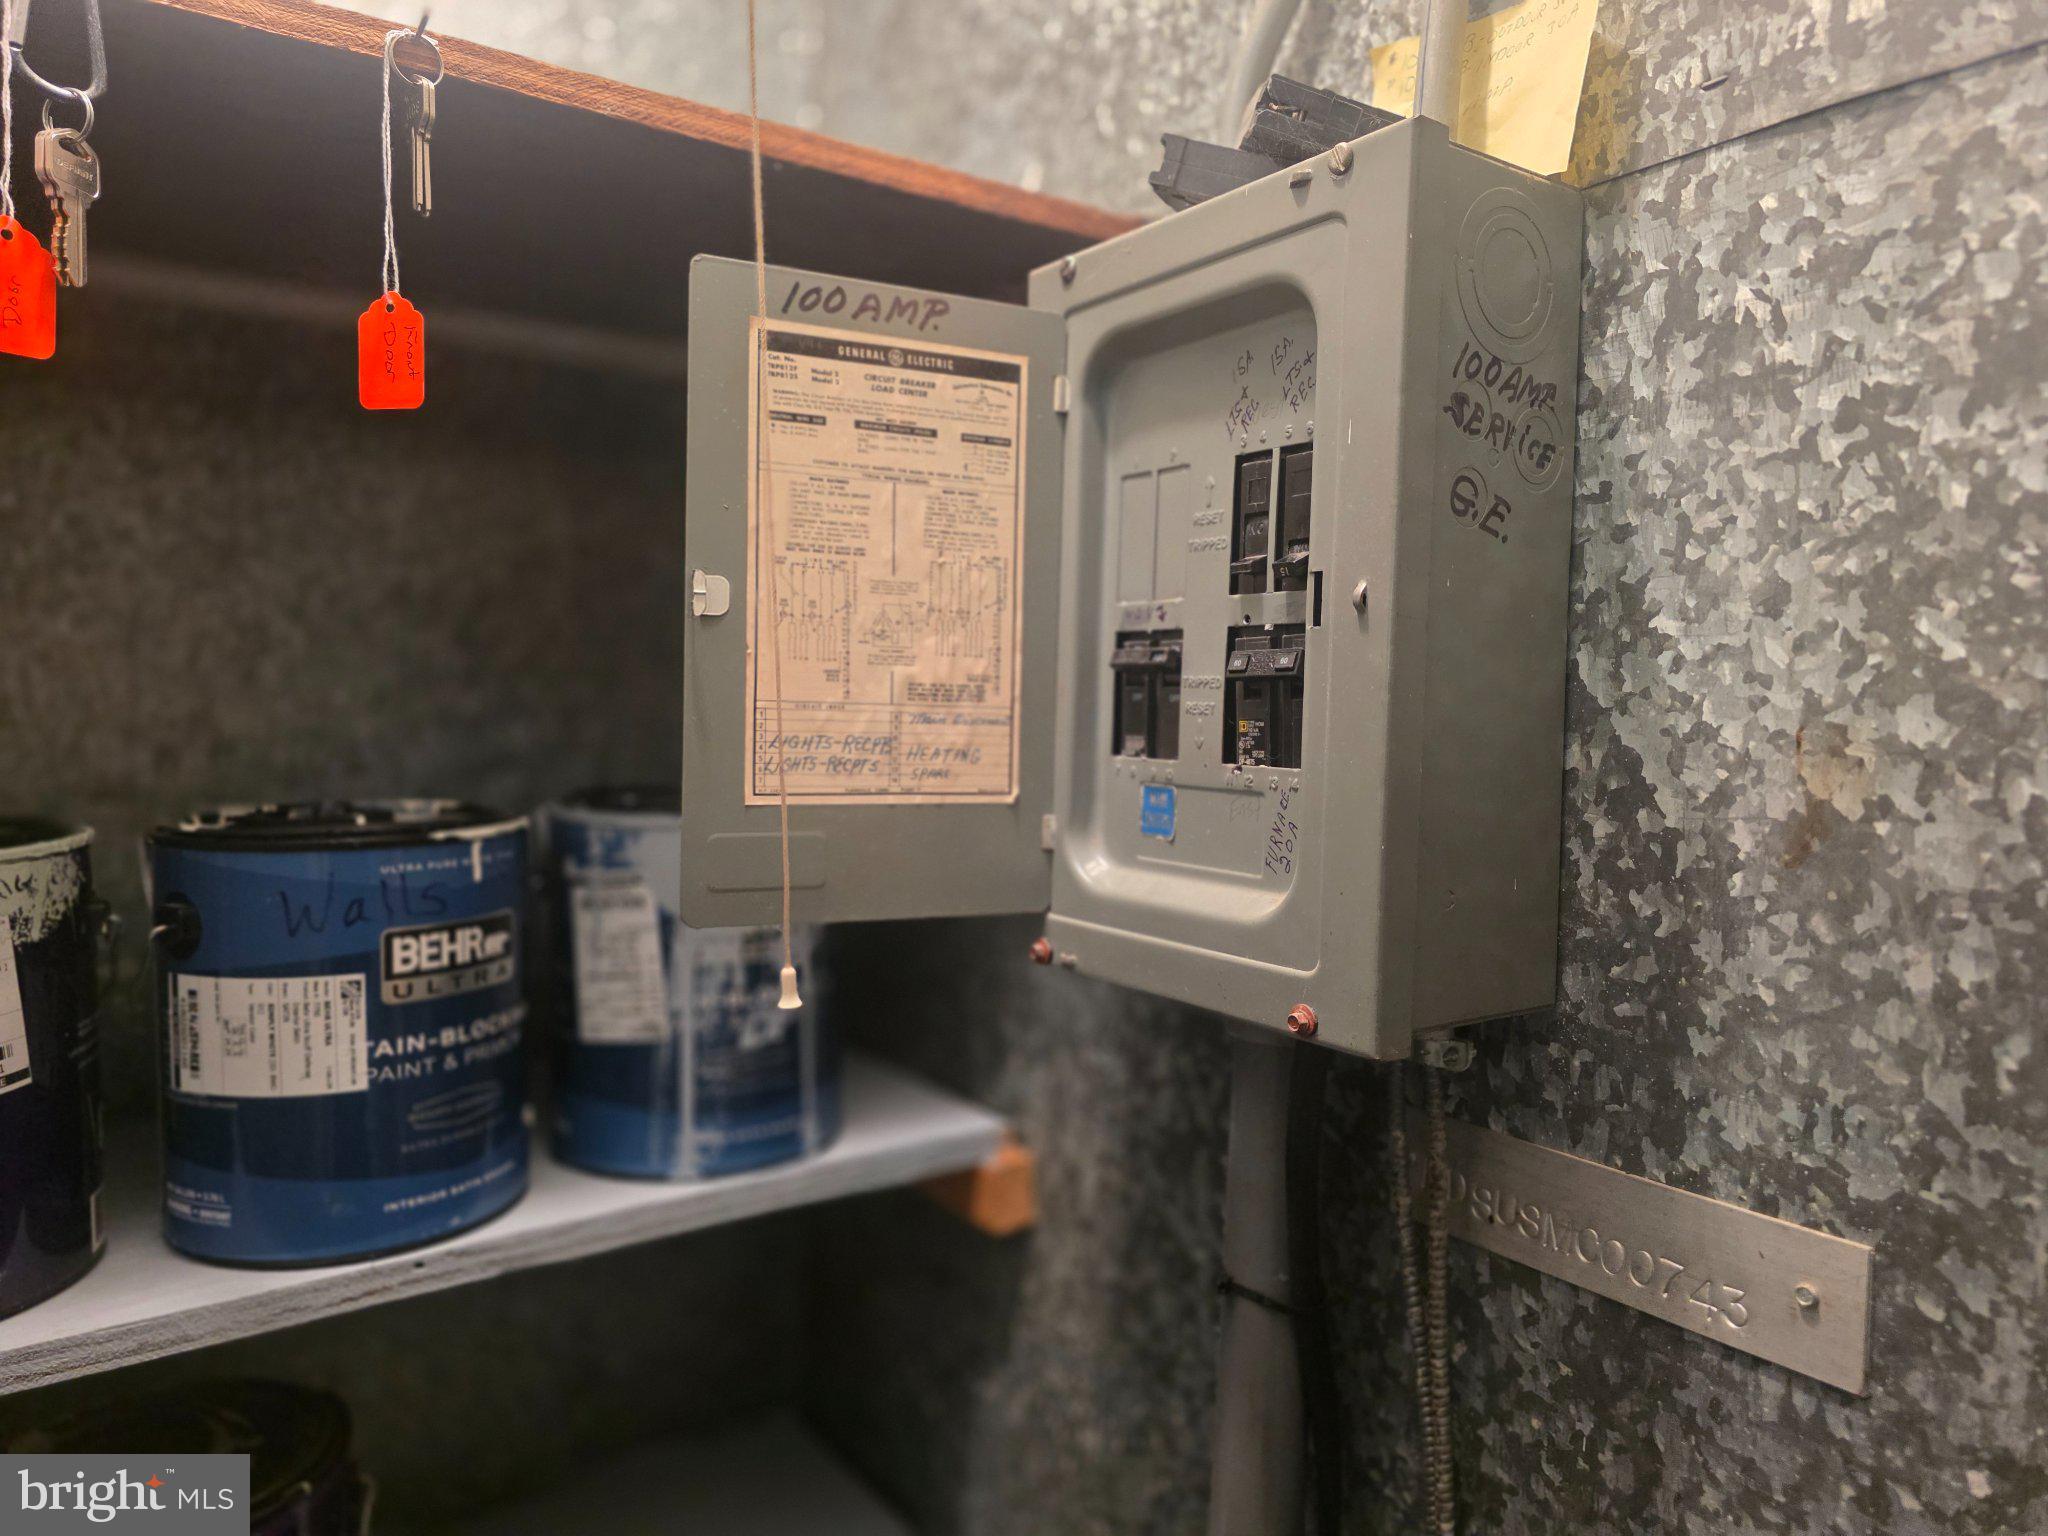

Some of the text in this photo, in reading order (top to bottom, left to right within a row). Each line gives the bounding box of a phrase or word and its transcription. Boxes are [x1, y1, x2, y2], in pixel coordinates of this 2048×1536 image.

[2, 275, 23, 328] Door
[782, 282, 847, 314] 100
[383, 322, 397, 383] Door
[404, 326, 420, 381] Front
[838, 345, 954, 371] GENERAL ELECTRIC
[1453, 341, 1503, 388] 100
[864, 373, 937, 390] CIRCUIT BREAKER
[871, 383, 896, 394] LOAD
[1192, 509, 1225, 528] RESET
[1187, 536, 1229, 553] TRIPPED
[1181, 675, 1223, 690] TRIPPED
[1184, 701, 1217, 717] RESET
[279, 871, 448, 938] Walls
[391, 925, 484, 975] BEHR
[393, 965, 507, 999] ULTRA
